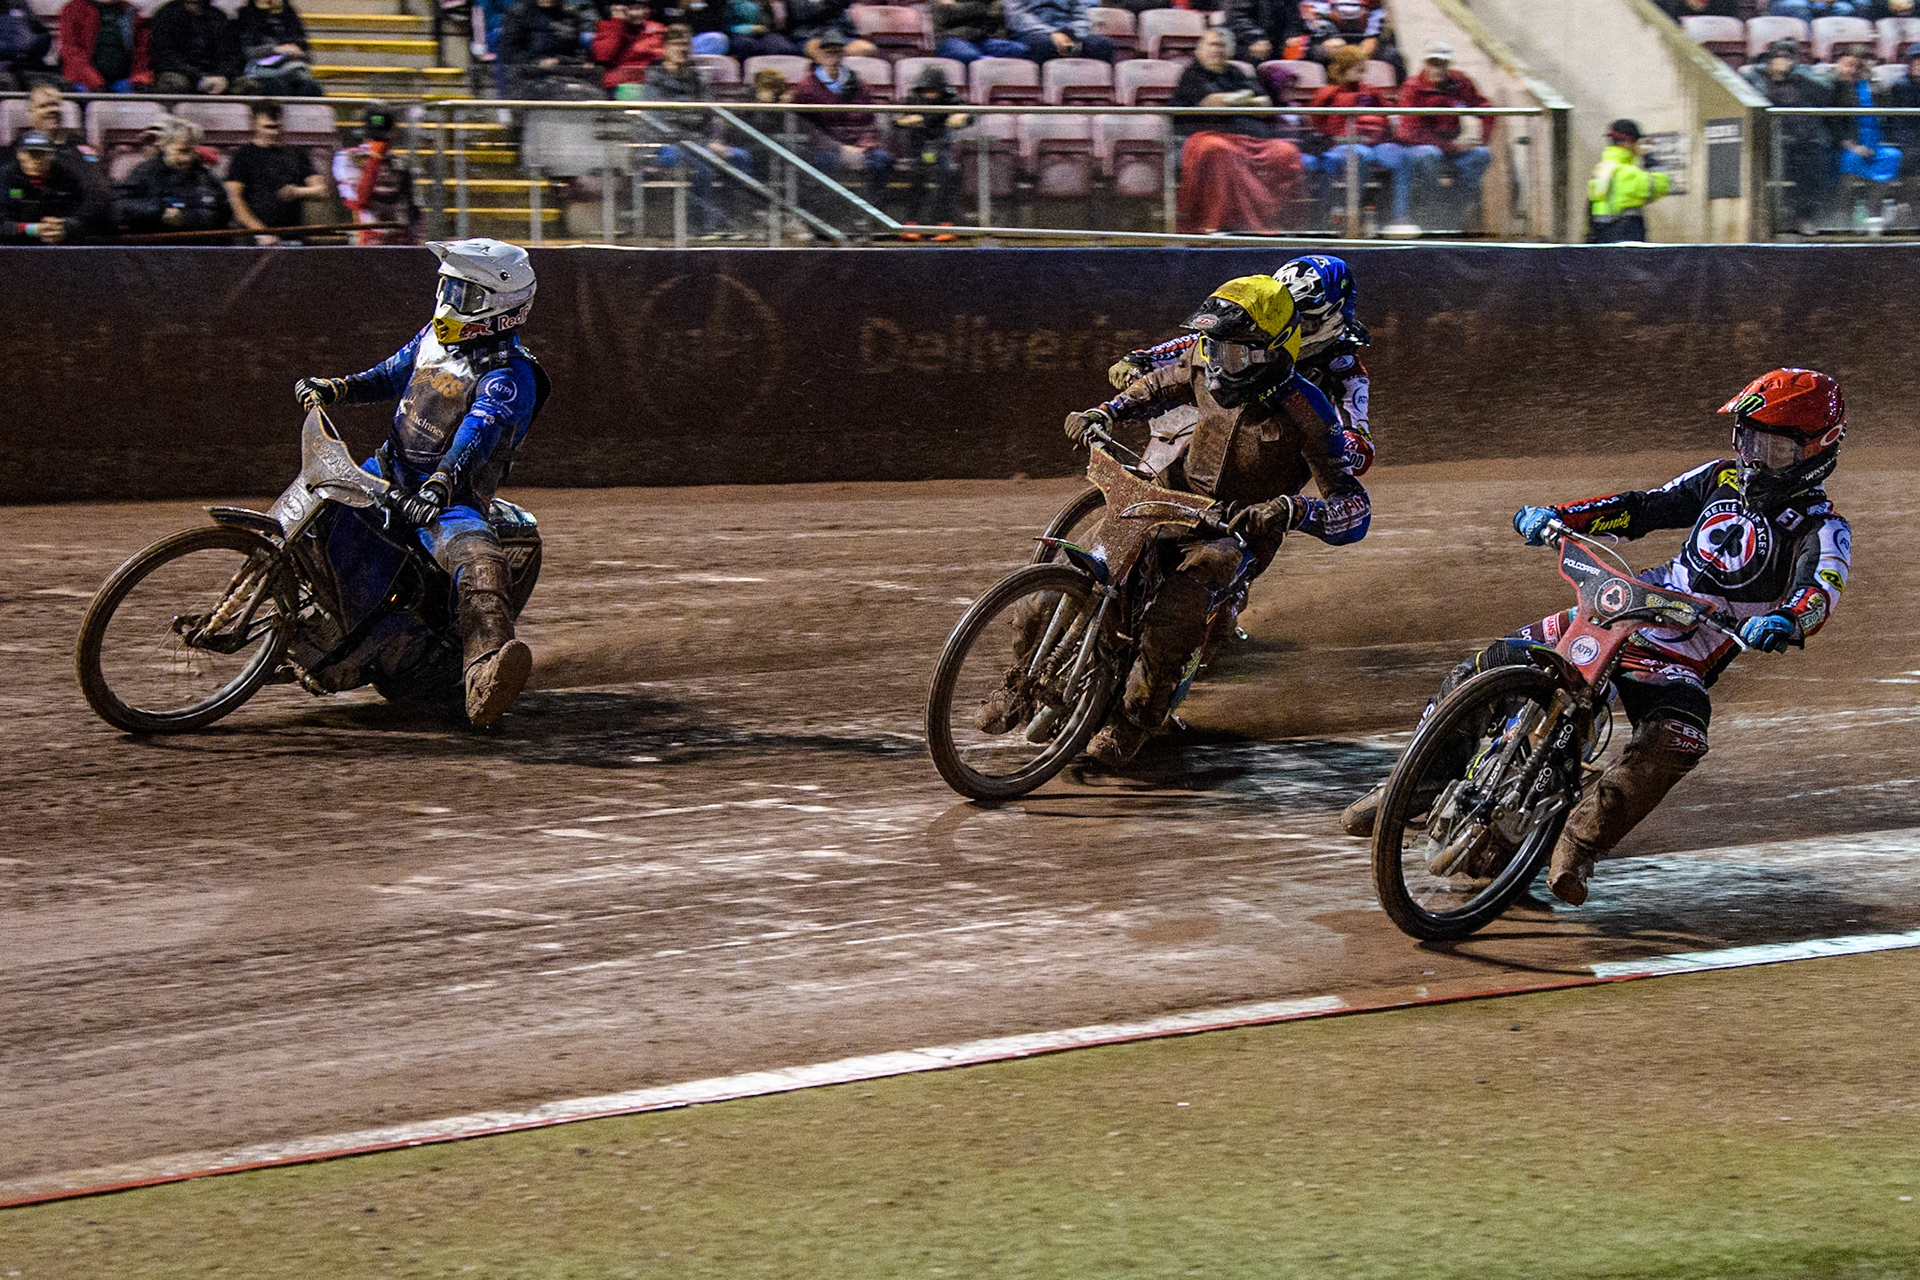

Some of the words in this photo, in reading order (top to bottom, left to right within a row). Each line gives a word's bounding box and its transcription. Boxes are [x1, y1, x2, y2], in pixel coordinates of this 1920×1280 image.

[858, 312, 1147, 376] Deliverin
[491, 381, 513, 396] ATPI
[1703, 502, 1738, 518] BELLE
[1756, 526, 1767, 556] ACES
[1563, 557, 1601, 576] POLCOPPER
[1575, 643, 1594, 657] ATPI
[1555, 723, 1574, 750] GEO
[1535, 766, 1553, 793] GEO
